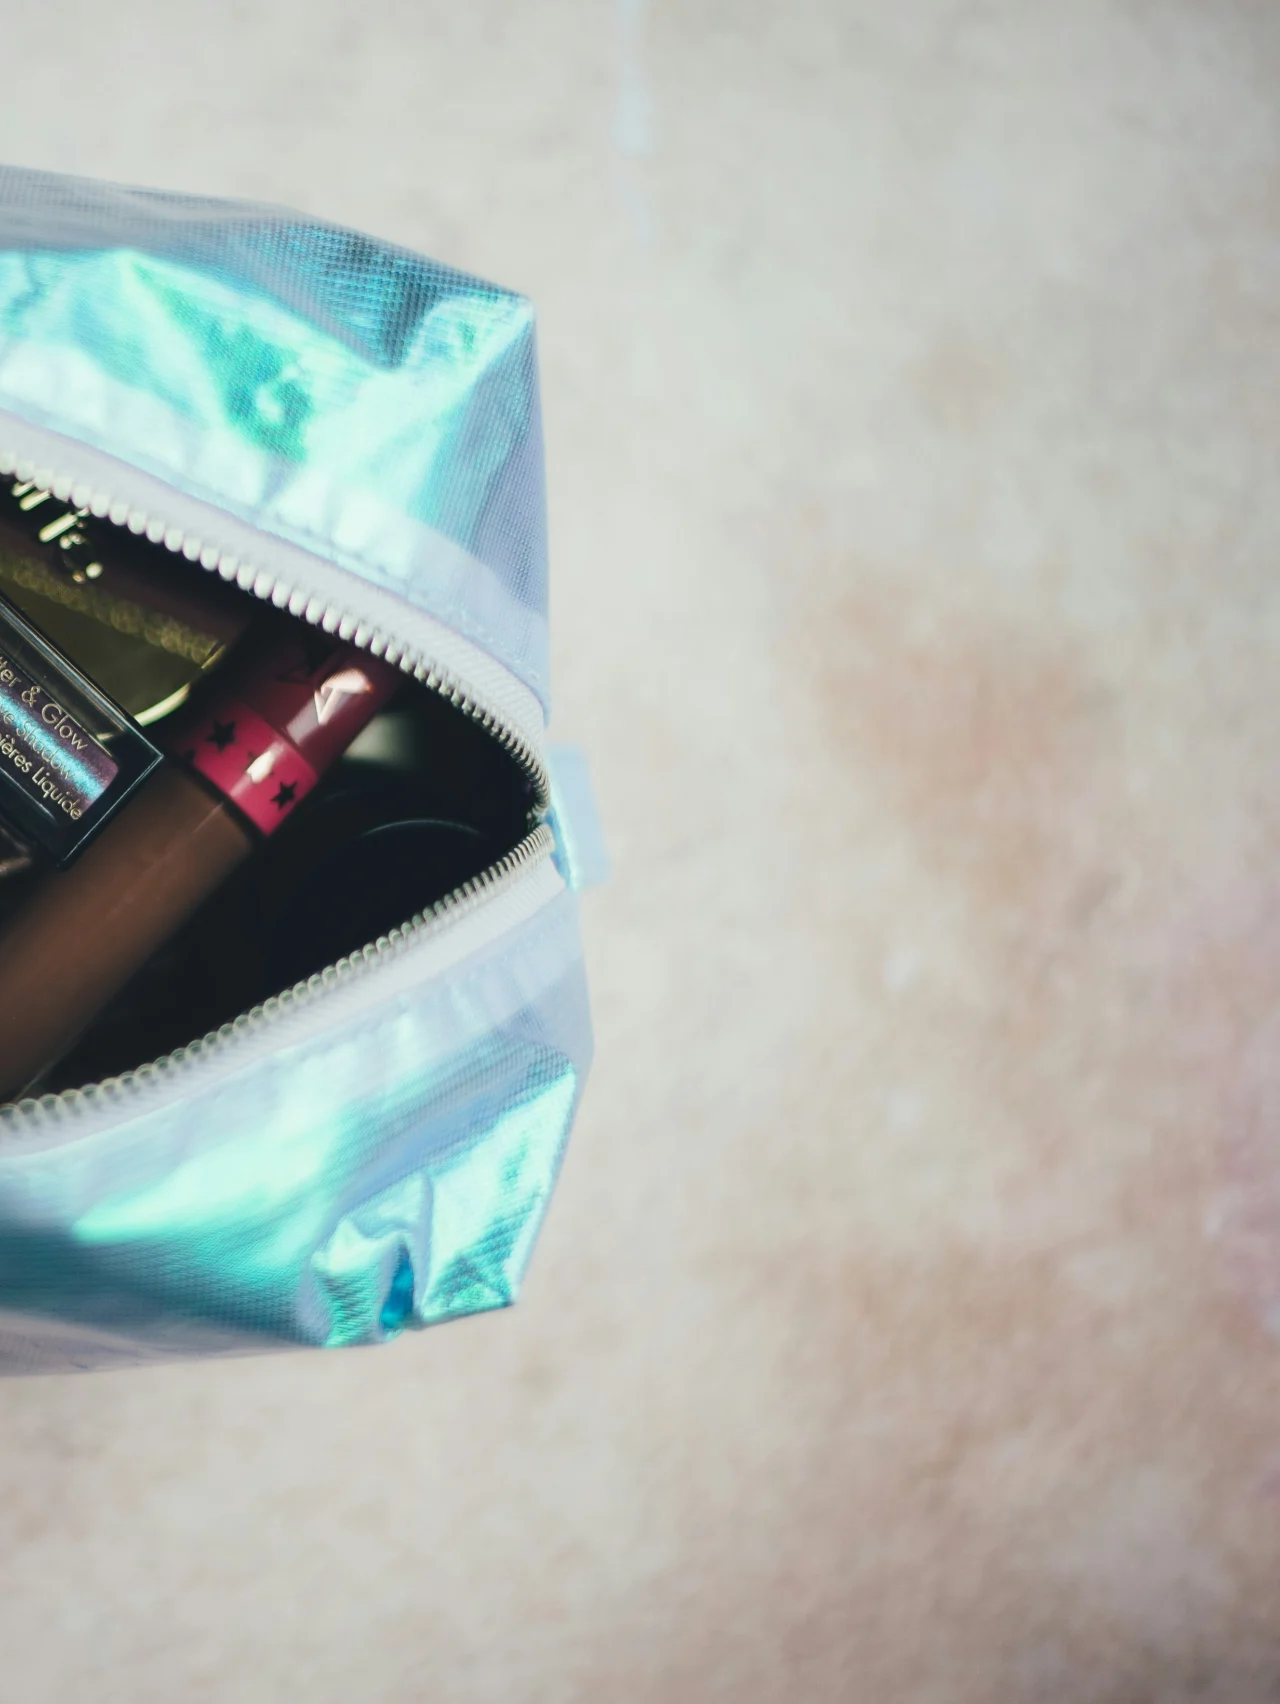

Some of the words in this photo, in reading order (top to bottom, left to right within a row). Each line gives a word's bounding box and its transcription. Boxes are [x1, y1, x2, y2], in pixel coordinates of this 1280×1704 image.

[22, 686, 40, 707] &
[41, 703, 88, 751] Glow
[15, 720, 73, 780] Shadow
[31, 767, 83, 820] Liquide
